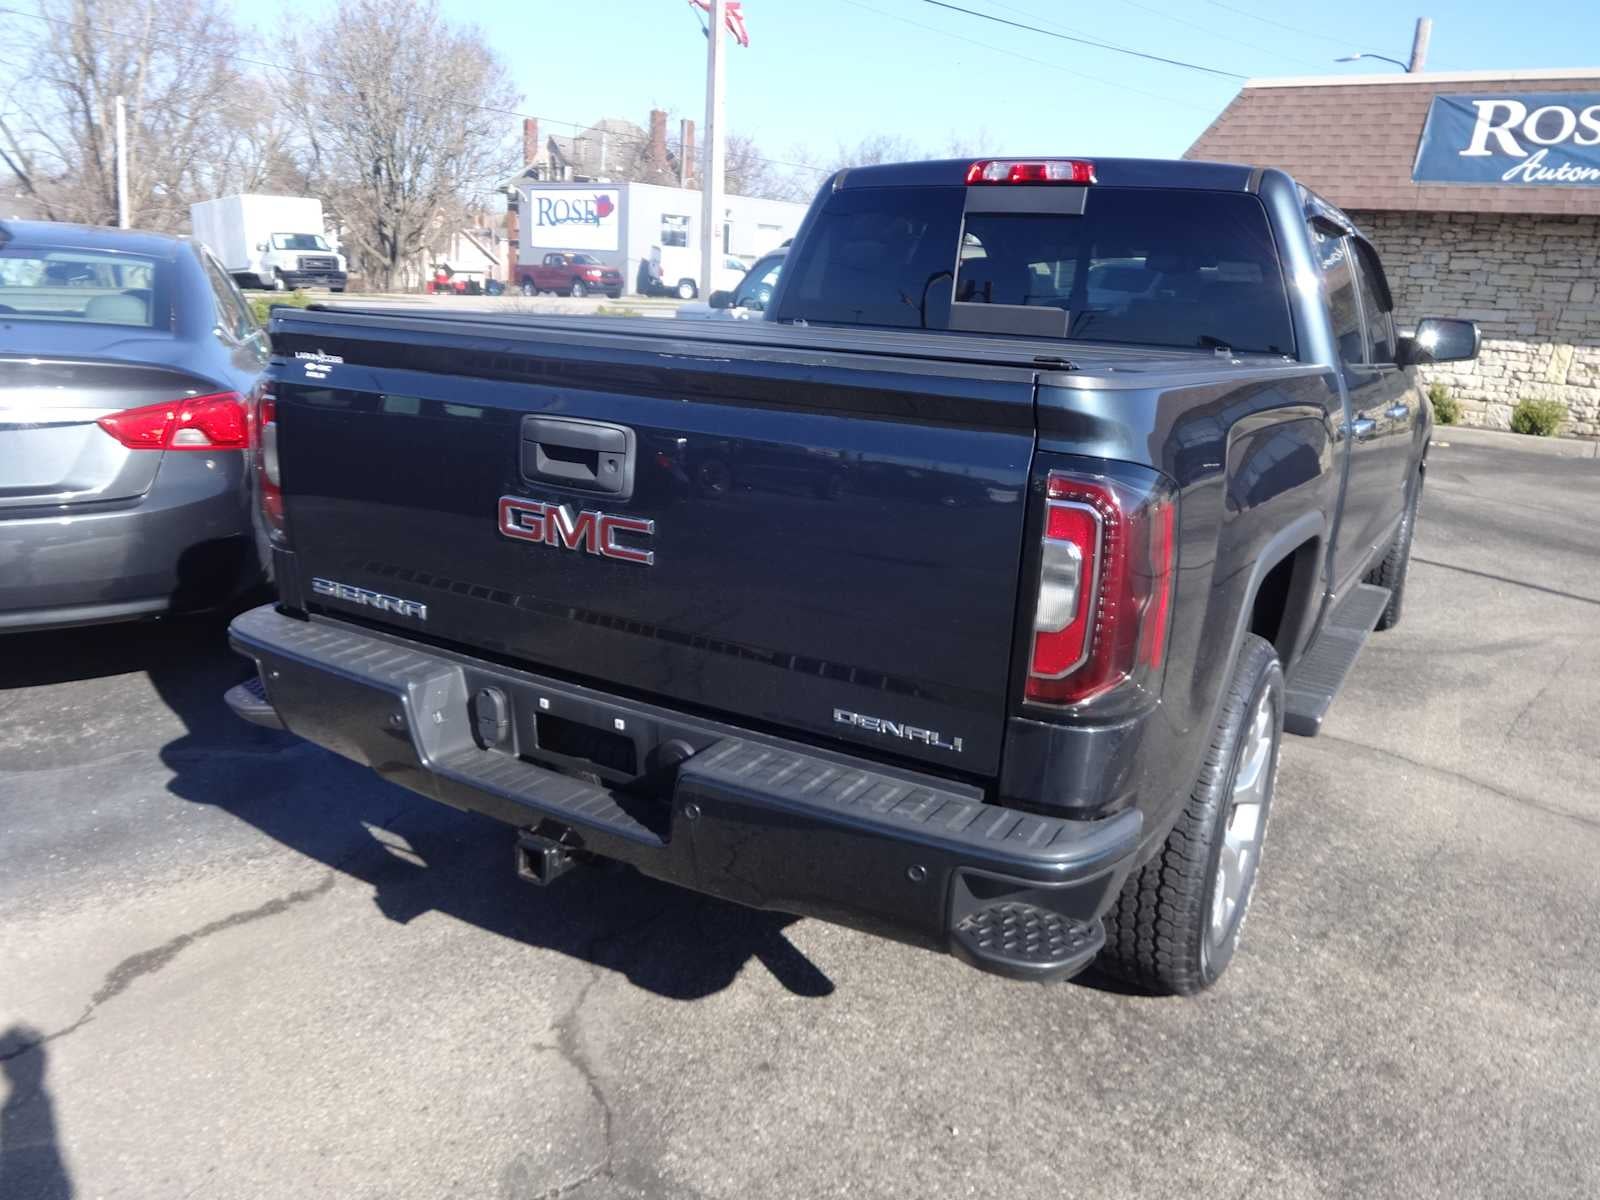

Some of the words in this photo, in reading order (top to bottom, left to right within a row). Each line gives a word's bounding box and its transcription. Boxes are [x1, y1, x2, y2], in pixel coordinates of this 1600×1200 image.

[536, 197, 599, 227] ROSE
[498, 495, 655, 565] GMC
[312, 577, 427, 620] SIERRA
[833, 708, 963, 752] DENALI
